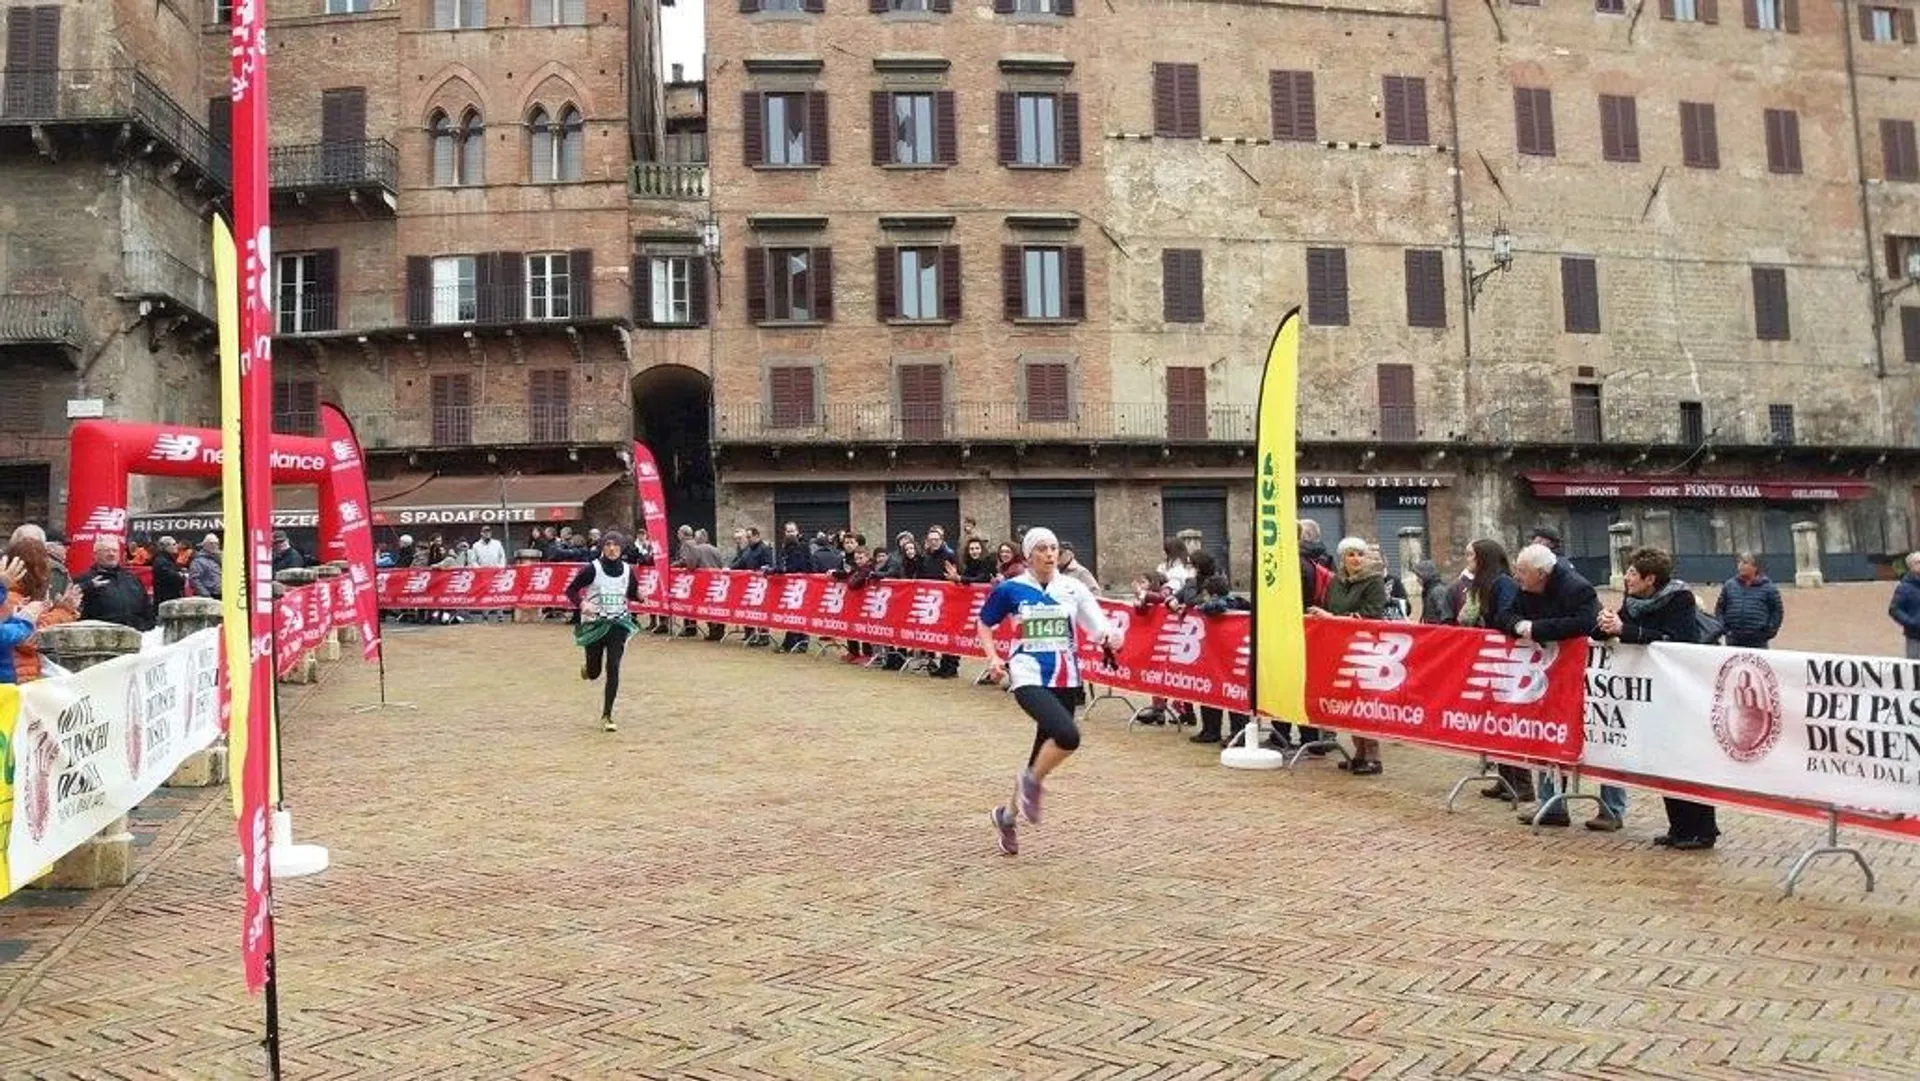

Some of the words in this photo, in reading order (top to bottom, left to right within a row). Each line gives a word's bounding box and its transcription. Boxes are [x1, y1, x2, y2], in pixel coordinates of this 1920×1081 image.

[203, 449, 223, 464] ne
[1367, 477, 1441, 487] OTTICA
[1565, 486, 1620, 496] RISTORANTE
[1684, 483, 1726, 496] FONTE
[1730, 484, 1761, 497] GAIA
[1302, 494, 1342, 504] OTTICA
[1399, 496, 1426, 506] FOTO
[133, 516, 224, 531] RISTORAN
[400, 508, 535, 525] SPADAFORTE
[1026, 620, 1065, 636] 1146
[1165, 668, 1212, 694] balance
[1584, 673, 1653, 702] ASCHI
[1319, 696, 1352, 714] new
[1353, 697, 1425, 726] balance
[1805, 691, 1860, 721] DEI
[1869, 695, 1920, 727] PAS
[1442, 710, 1482, 731] new
[1483, 712, 1568, 744] balance
[1602, 731, 1627, 747] 1472
[1806, 724, 1838, 753] DI
[1845, 727, 1920, 762] SIEN
[1806, 757, 1866, 778] BANCA
[1873, 764, 1910, 784] DAL
